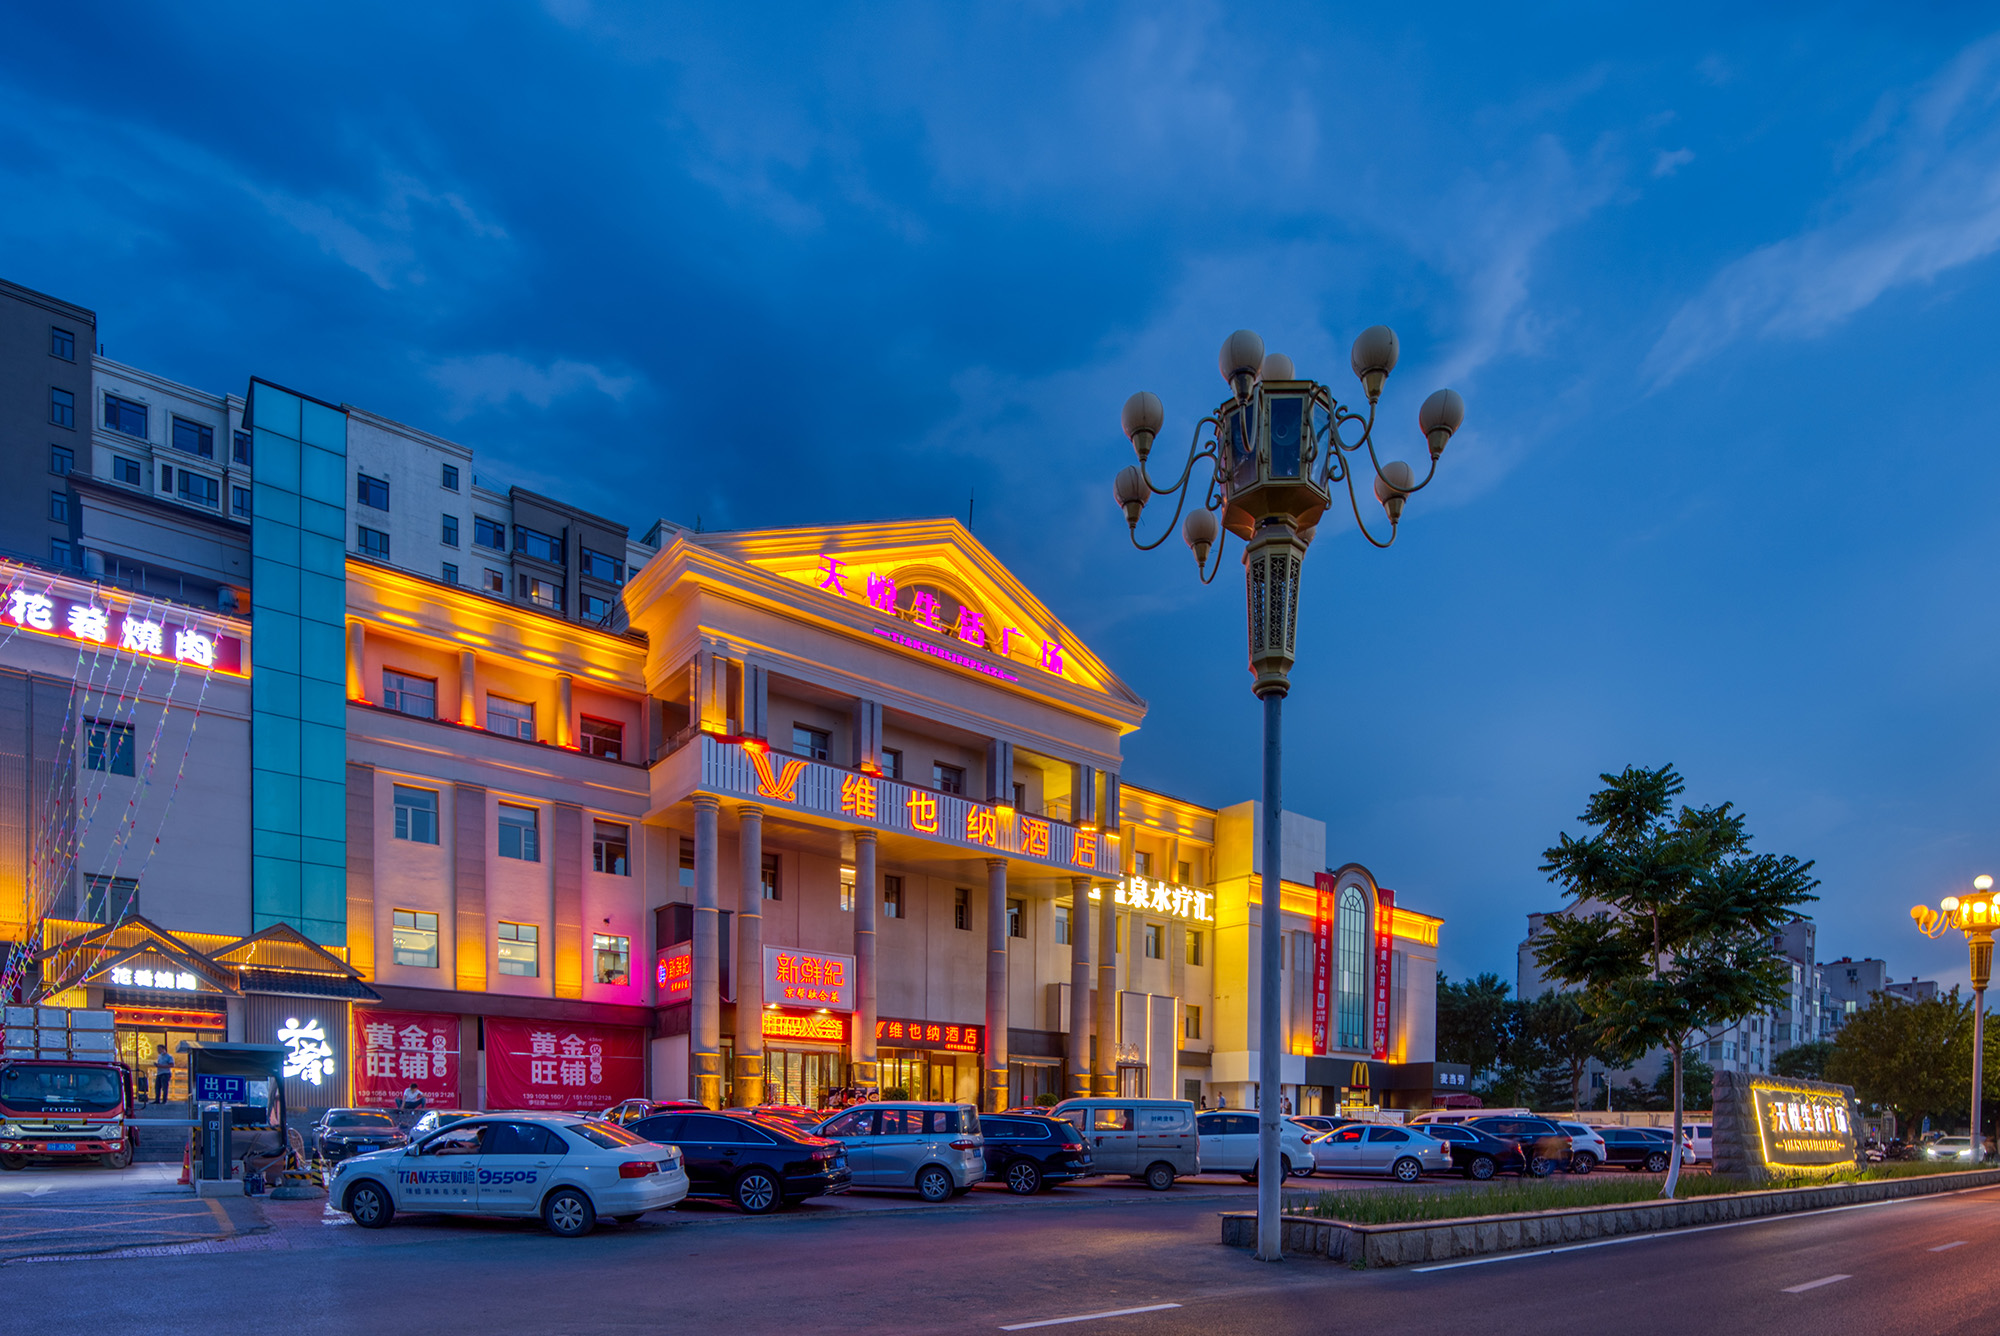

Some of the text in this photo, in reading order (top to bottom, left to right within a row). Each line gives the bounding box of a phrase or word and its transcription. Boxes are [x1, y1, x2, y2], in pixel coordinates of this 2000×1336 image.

[817, 553, 1063, 675] 天悦生活广场
[890, 631, 1005, 680] TIANYUELIFEPLAZA
[841, 773, 1098, 868] 维也纳酒店
[1318, 896, 1329, 991] 麦当劳盛大开幕
[1378, 910, 1390, 999] 麦当劳盛大开幕
[366, 1022, 429, 1051] 黄金
[530, 1032, 586, 1059] 黄金
[888, 1021, 977, 1044] 维也纳酒店
[366, 1052, 430, 1079] 旺铺
[531, 1060, 586, 1086] 旺铺
[204, 1077, 239, 1091] 出口
[1440, 1073, 1465, 1086] 麦当劳
[209, 1092, 234, 1100] EXIT
[1774, 1102, 1847, 1133] 天悦生活广场
[479, 1169, 537, 1185] 95505
